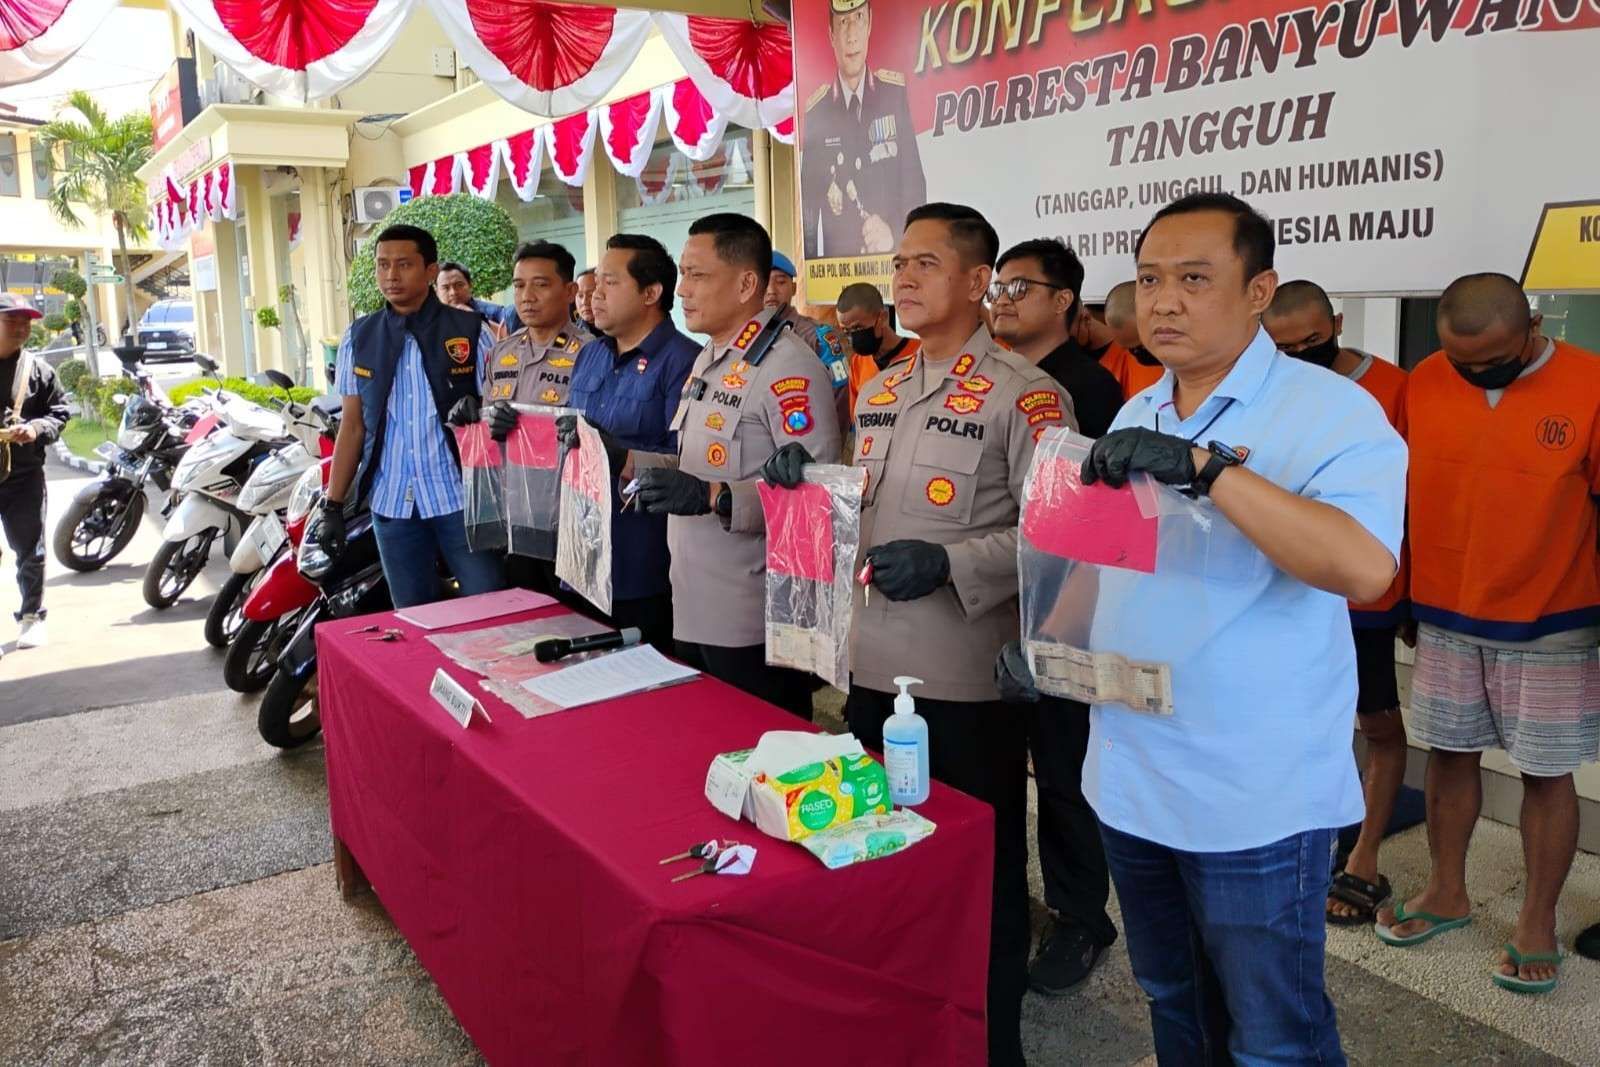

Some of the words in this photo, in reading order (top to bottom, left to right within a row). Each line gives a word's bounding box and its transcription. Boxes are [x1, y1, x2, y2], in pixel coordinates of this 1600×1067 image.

[932, 46, 1157, 137] POLRESTA
[1107, 92, 1336, 167] TANGGUH
[1035, 186, 1134, 219] (TANGGAP,
[1241, 167, 1293, 196] DAN
[1298, 149, 1444, 191] HUMANIS)
[1348, 207, 1435, 242] MAJU
[712, 390, 742, 409] POLRI
[858, 411, 898, 428] TEGUH
[926, 415, 985, 441] POLRI
[1542, 418, 1569, 446] 106
